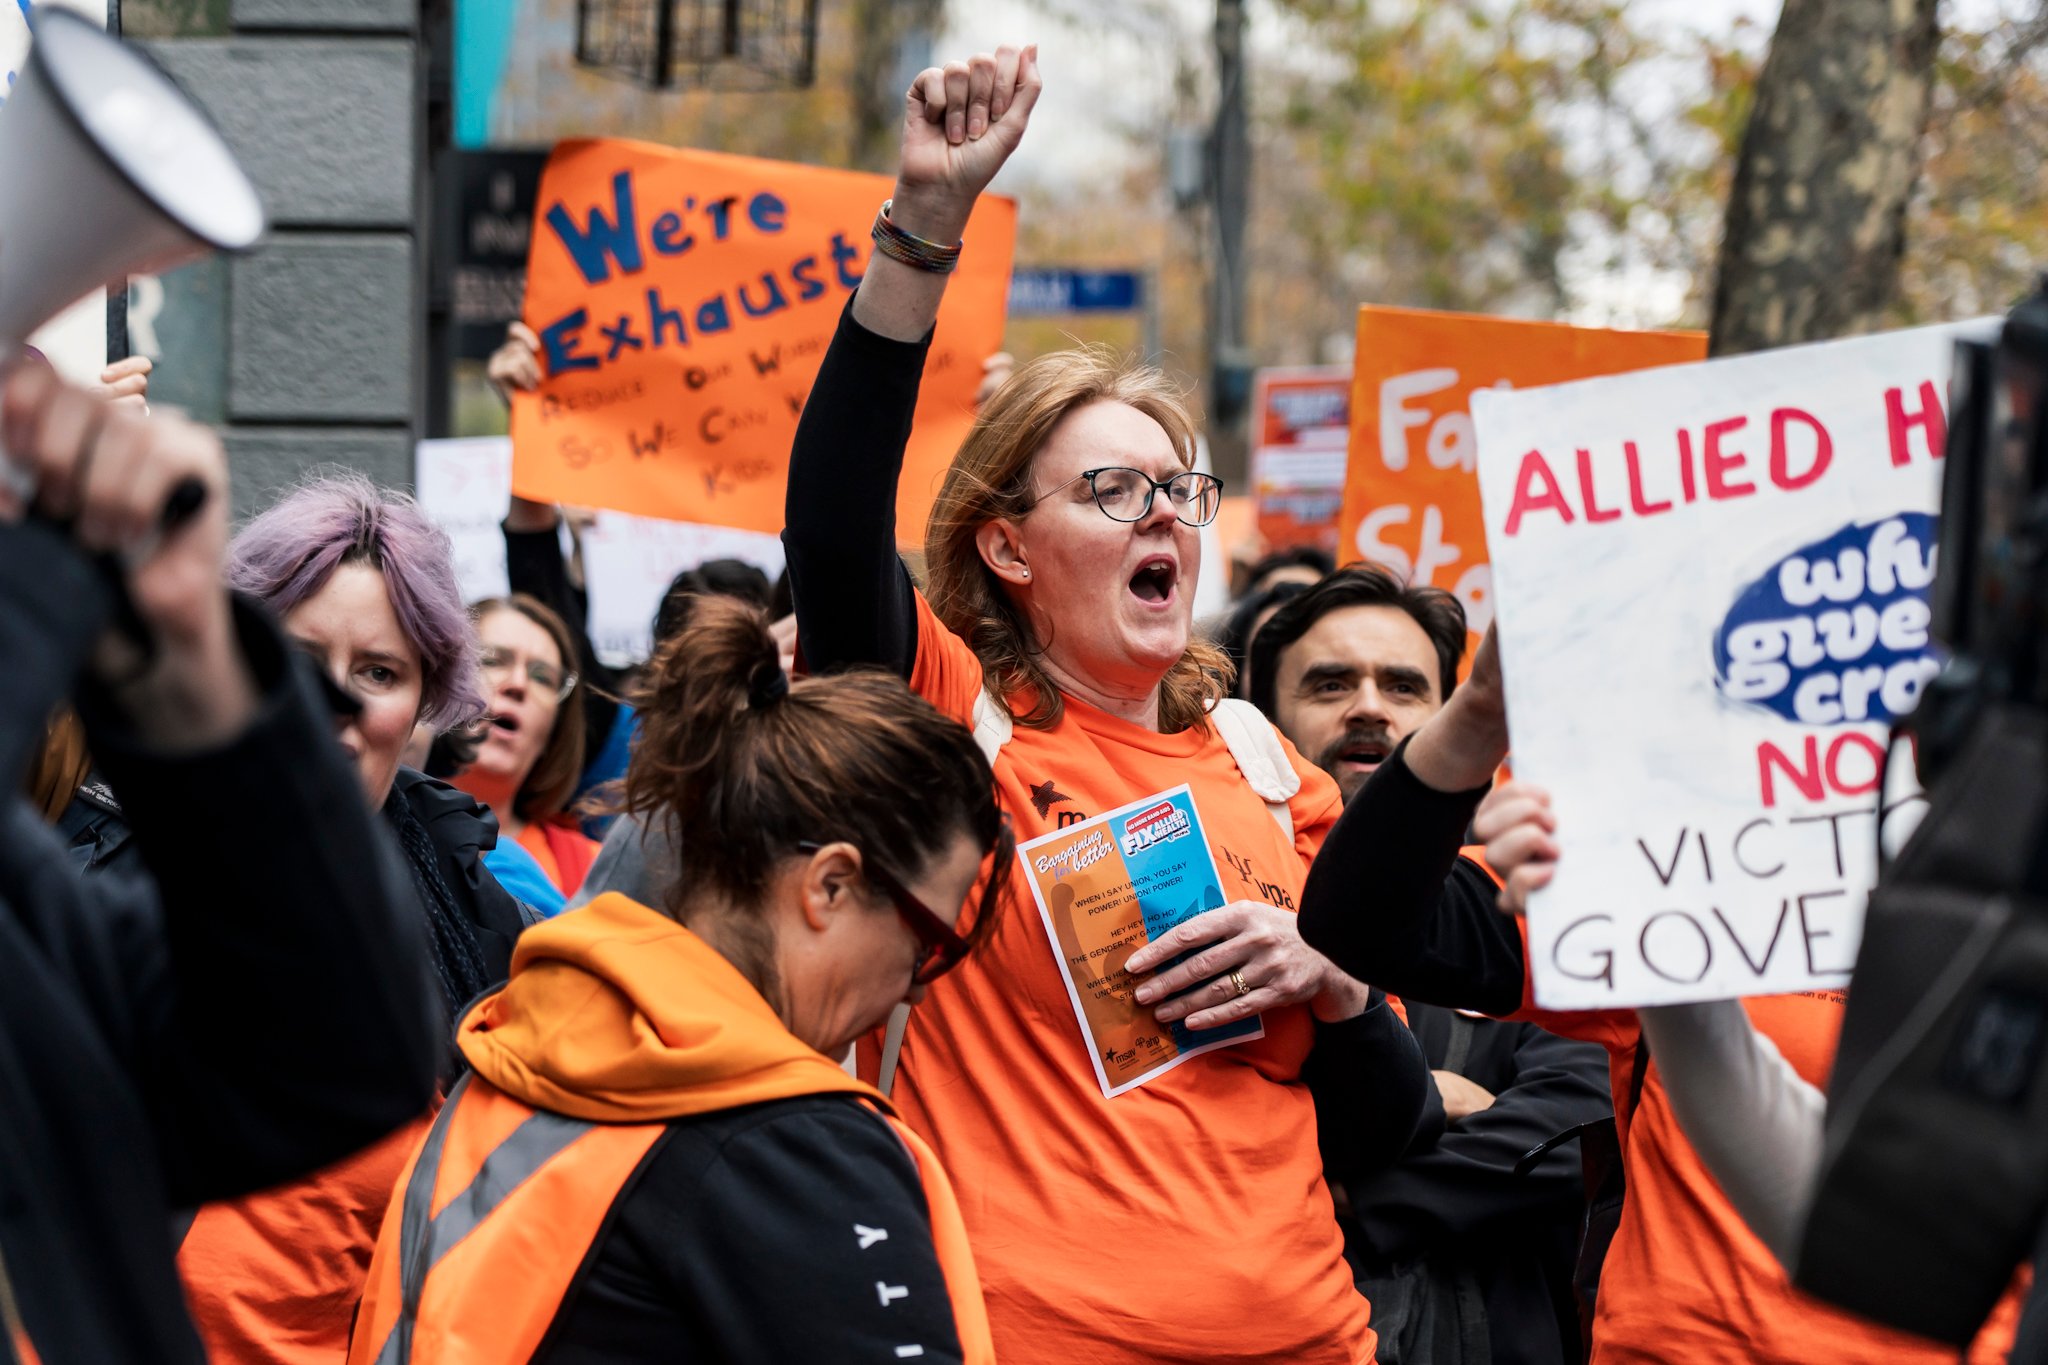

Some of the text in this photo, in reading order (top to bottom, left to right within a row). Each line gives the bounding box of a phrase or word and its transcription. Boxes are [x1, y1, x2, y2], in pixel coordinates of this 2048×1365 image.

[545, 169, 789, 286] We're
[540, 230, 862, 377] Exhaust
[1378, 366, 1480, 474] Fa
[1503, 378, 1950, 537] ALLIED H
[1779, 517, 1939, 607] wh
[1722, 596, 1932, 703] give
[1756, 730, 1892, 809] NO
[1120, 823, 1158, 853] FIX
[1154, 810, 1184, 831] ALLIED
[1155, 817, 1188, 839] HEALTH
[1035, 829, 1103, 874] Bargaining
[1073, 841, 1115, 872] better
[1636, 806, 1878, 888] VICT
[1074, 893, 1101, 909] WHEN
[1106, 885, 1123, 897] SAY
[1153, 867, 1171, 879] YOU
[1171, 861, 1188, 874] SAY
[1087, 876, 1184, 916] POWER! UNION! POWER!
[1070, 953, 1088, 966] THE
[1089, 939, 1125, 959] GENDER
[1124, 933, 1138, 945] PAY
[1139, 926, 1157, 938] GAP
[1110, 926, 1126, 939] HEY
[1146, 912, 1160, 923] HO
[1161, 907, 1177, 918] HO!
[1552, 888, 1855, 990] GOVE
[1086, 975, 1112, 990] WHEN
[1093, 983, 1122, 1000] UNDER
